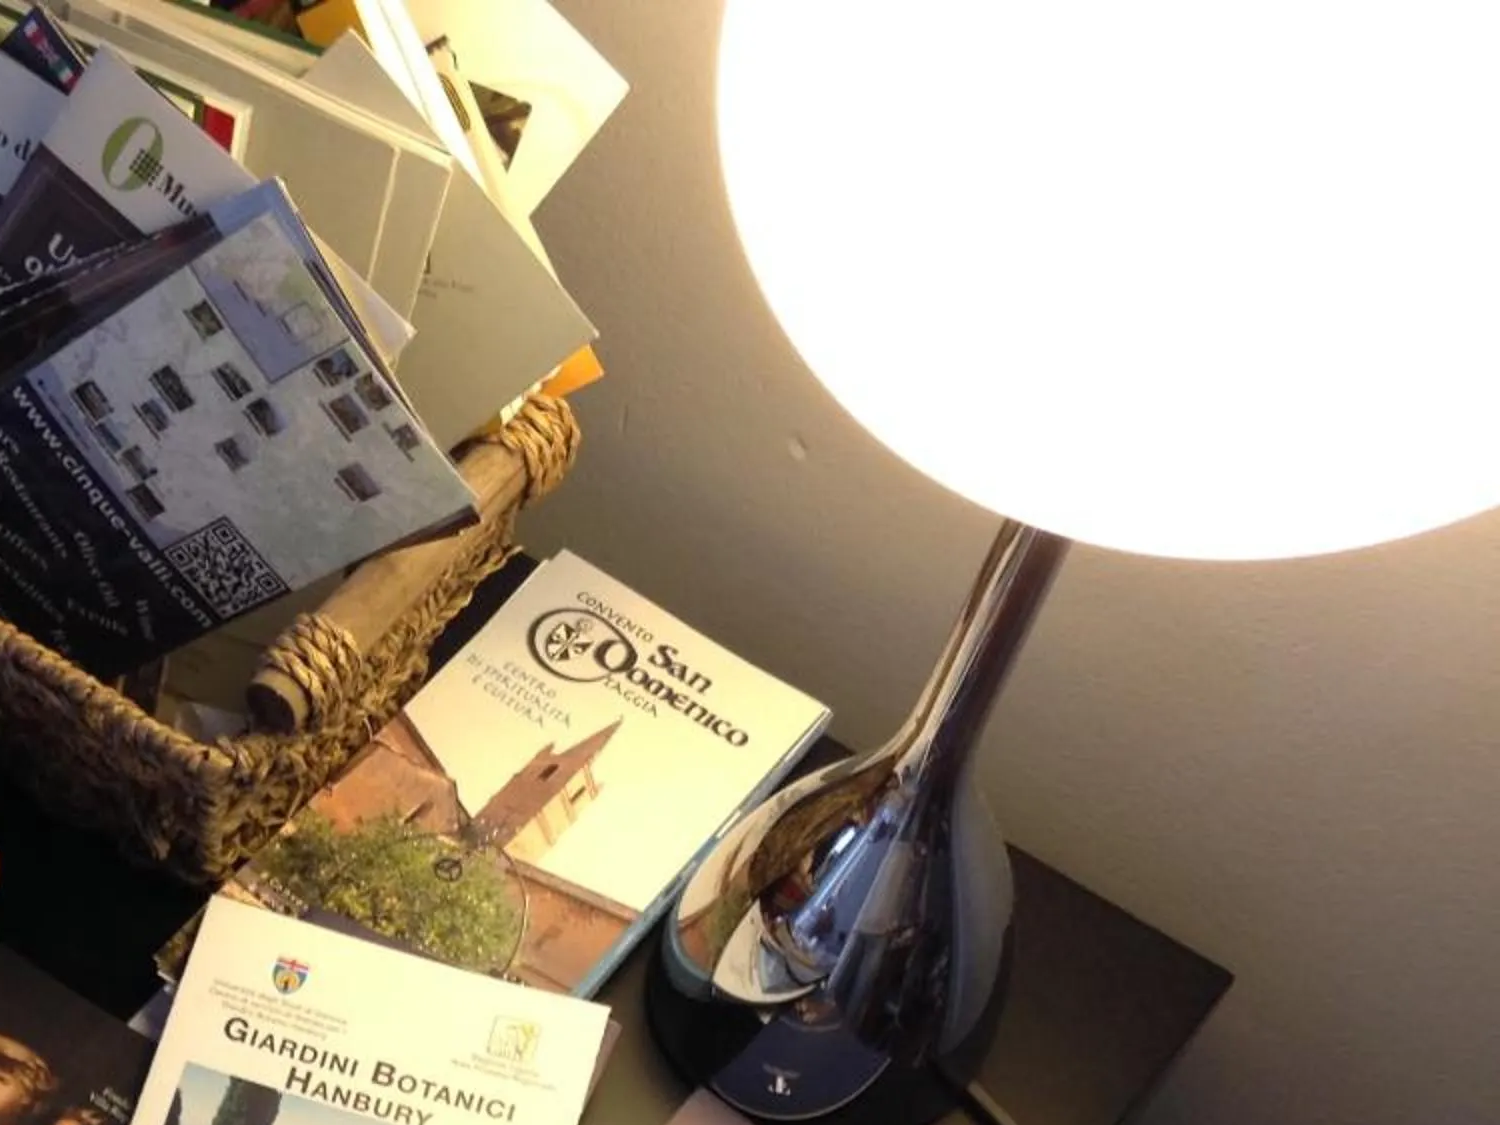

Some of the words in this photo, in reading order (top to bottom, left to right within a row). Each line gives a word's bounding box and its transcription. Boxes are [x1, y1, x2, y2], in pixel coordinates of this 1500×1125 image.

[14, 138, 34, 161] d
[12, 385, 212, 629] www.cinque-valli.com
[576, 590, 654, 643] CONVENTO
[503, 660, 557, 699] CENTRO
[647, 642, 714, 697] San
[604, 675, 658, 718] TAGGIA
[223, 1016, 360, 1078] GIARDINI
[370, 1060, 517, 1123] BOTANICI
